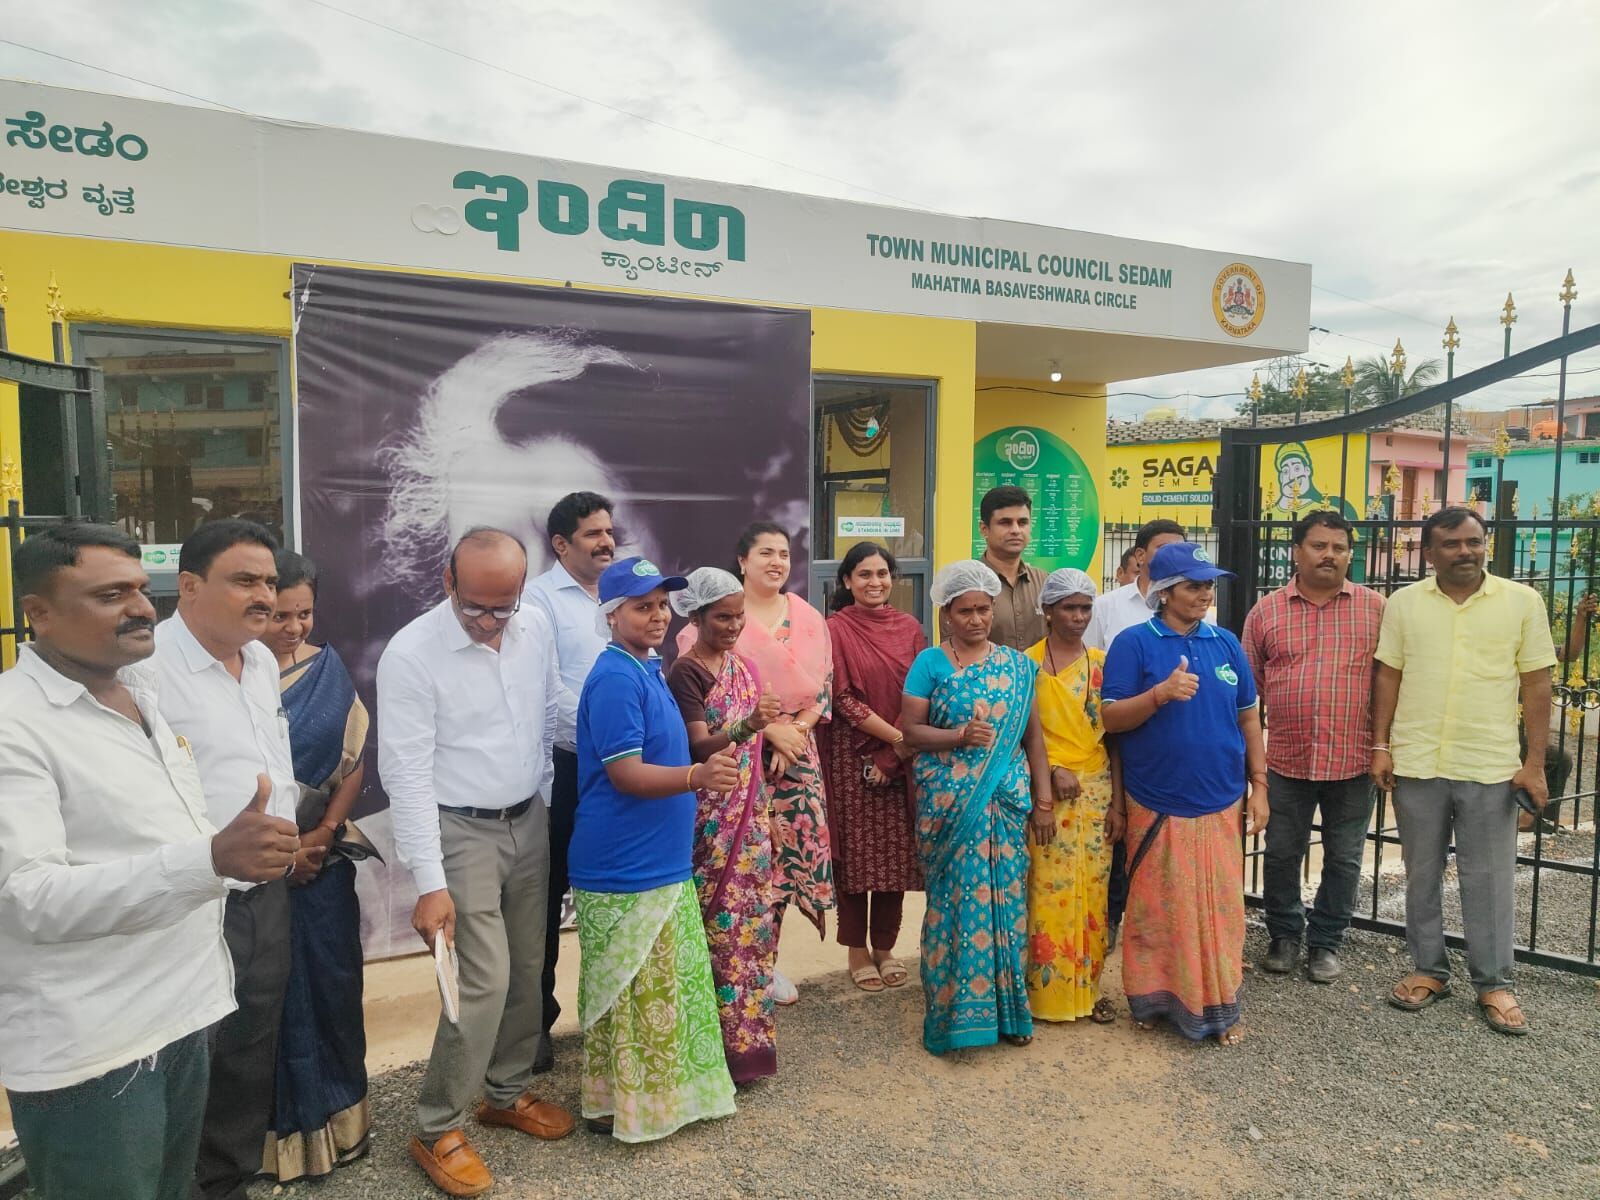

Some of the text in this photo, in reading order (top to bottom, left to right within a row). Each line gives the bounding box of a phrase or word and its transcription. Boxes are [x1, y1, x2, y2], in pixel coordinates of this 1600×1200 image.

[5, 110, 149, 162] ಸೇಡಂ
[82, 183, 136, 216] ವೃತ್ತ
[453, 170, 746, 262] ಇಂದಿರಾ
[601, 251, 723, 280] ಕ್ಯಾಂಟೀನ್
[866, 233, 1173, 289] TOWN MUNICIPAL COUNCIL SEDAM
[911, 272, 1137, 310] MAHATMA BASAVESHWARA CIRCLE
[1216, 266, 1256, 290] GOVERNMENT
[1220, 318, 1257, 335] KARNATAKA
[1142, 455, 1214, 478] SAGA
[1143, 494, 1162, 503] SOLID
[1162, 494, 1189, 503] CEMENT
[1190, 494, 1209, 502] SOLID
[1259, 546, 1292, 562] CON
